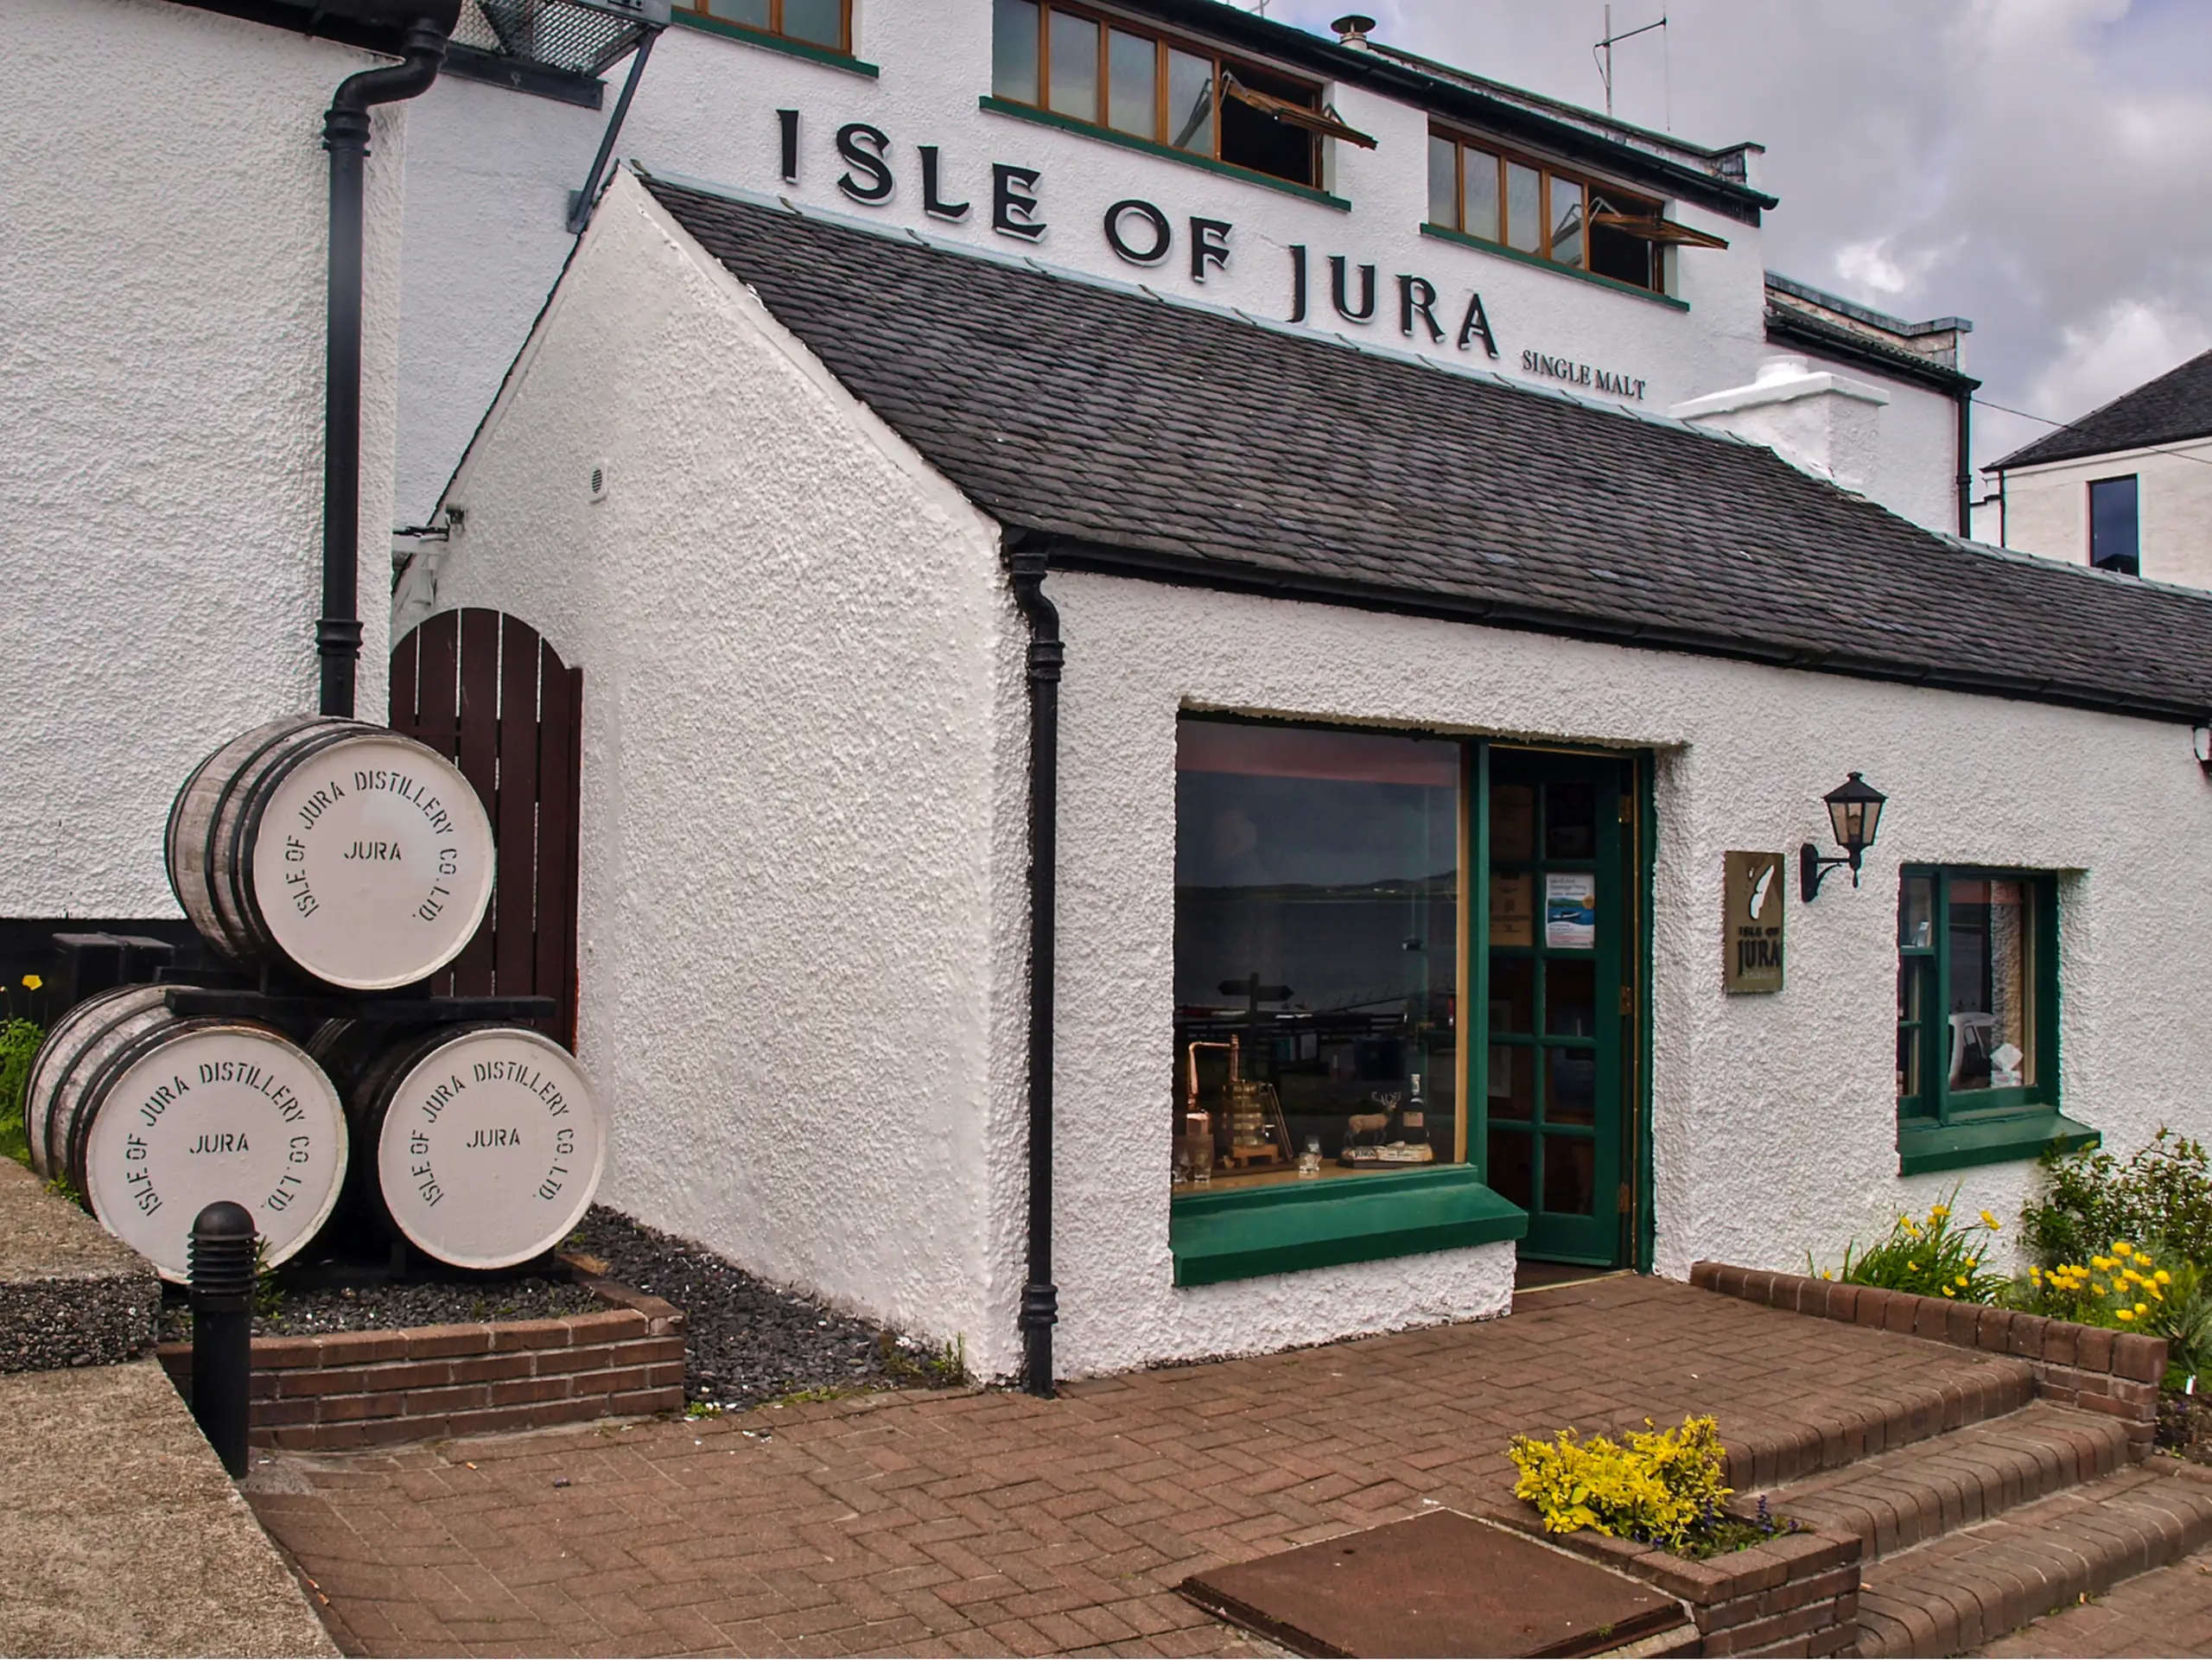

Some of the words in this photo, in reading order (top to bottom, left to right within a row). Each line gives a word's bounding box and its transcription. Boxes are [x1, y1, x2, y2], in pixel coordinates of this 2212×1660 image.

[776, 109, 1049, 244] ISLE
[1103, 199, 1234, 283] OF
[1285, 244, 1501, 359] JURA
[1522, 349, 1591, 386] SINGLE
[1595, 368, 1646, 401] MALT
[298, 781, 346, 830] JURA
[354, 771, 454, 835] DISTILLERY
[285, 835, 306, 862] OF
[344, 842, 402, 861] JURA
[285, 868, 320, 918] ISLE
[1738, 939, 1781, 977] JURA
[140, 1076, 190, 1127] JURA
[199, 1062, 305, 1123] DISTILLERY
[422, 1075, 467, 1123] JURA
[474, 1061, 569, 1116] DISTILLERY
[125, 1133, 148, 1160] OF
[189, 1133, 249, 1154] JURA
[410, 1129, 429, 1154] OF
[467, 1128, 520, 1148] JURA
[126, 1167, 163, 1217] ISLE
[411, 1161, 444, 1206] ISLE
